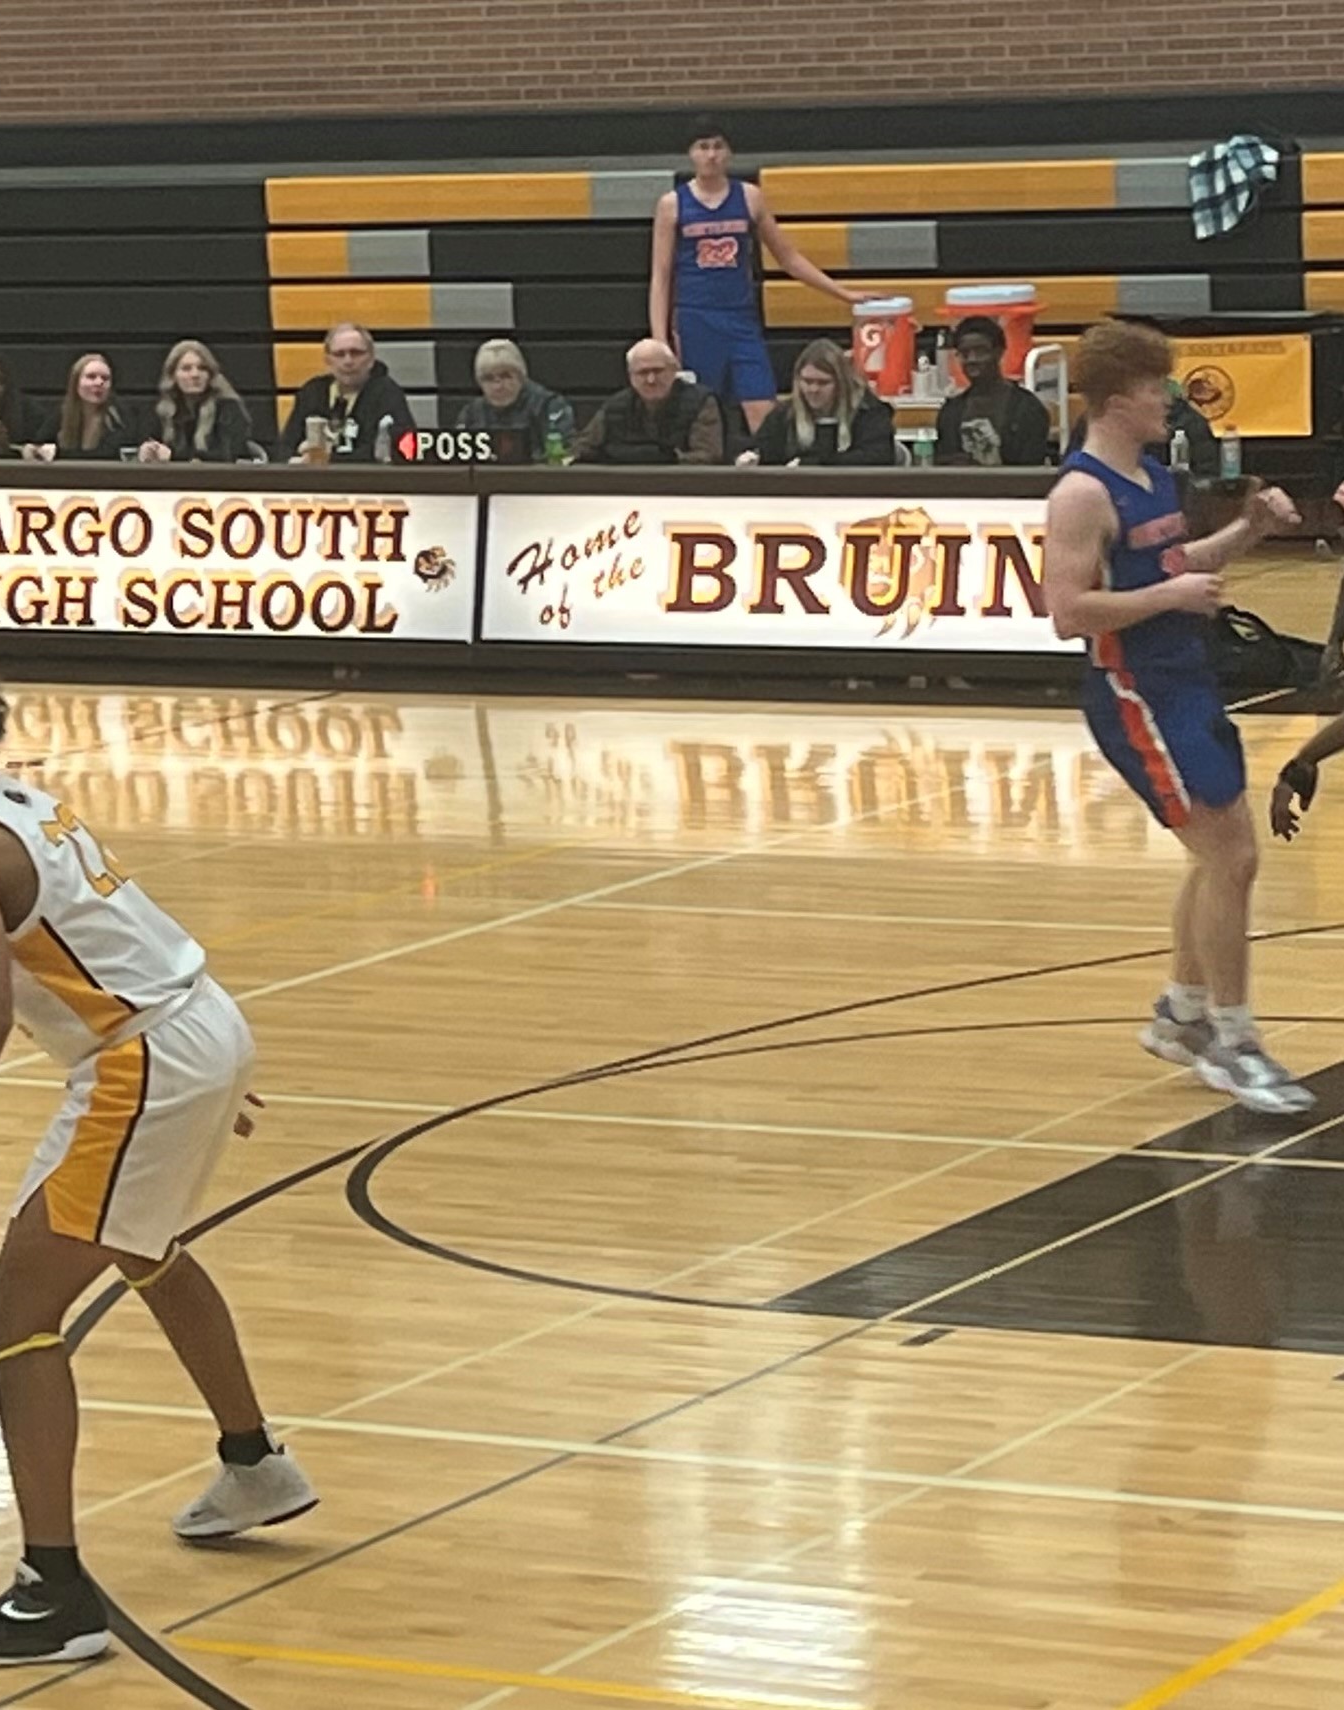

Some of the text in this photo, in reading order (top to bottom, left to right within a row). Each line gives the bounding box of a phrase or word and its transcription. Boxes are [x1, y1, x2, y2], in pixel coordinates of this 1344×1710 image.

[178, 506, 409, 562] SOUTH
[506, 509, 643, 595] Home
[121, 576, 399, 634] SCHOOL
[539, 551, 646, 630] of the
[663, 530, 1051, 618] BRUIN
